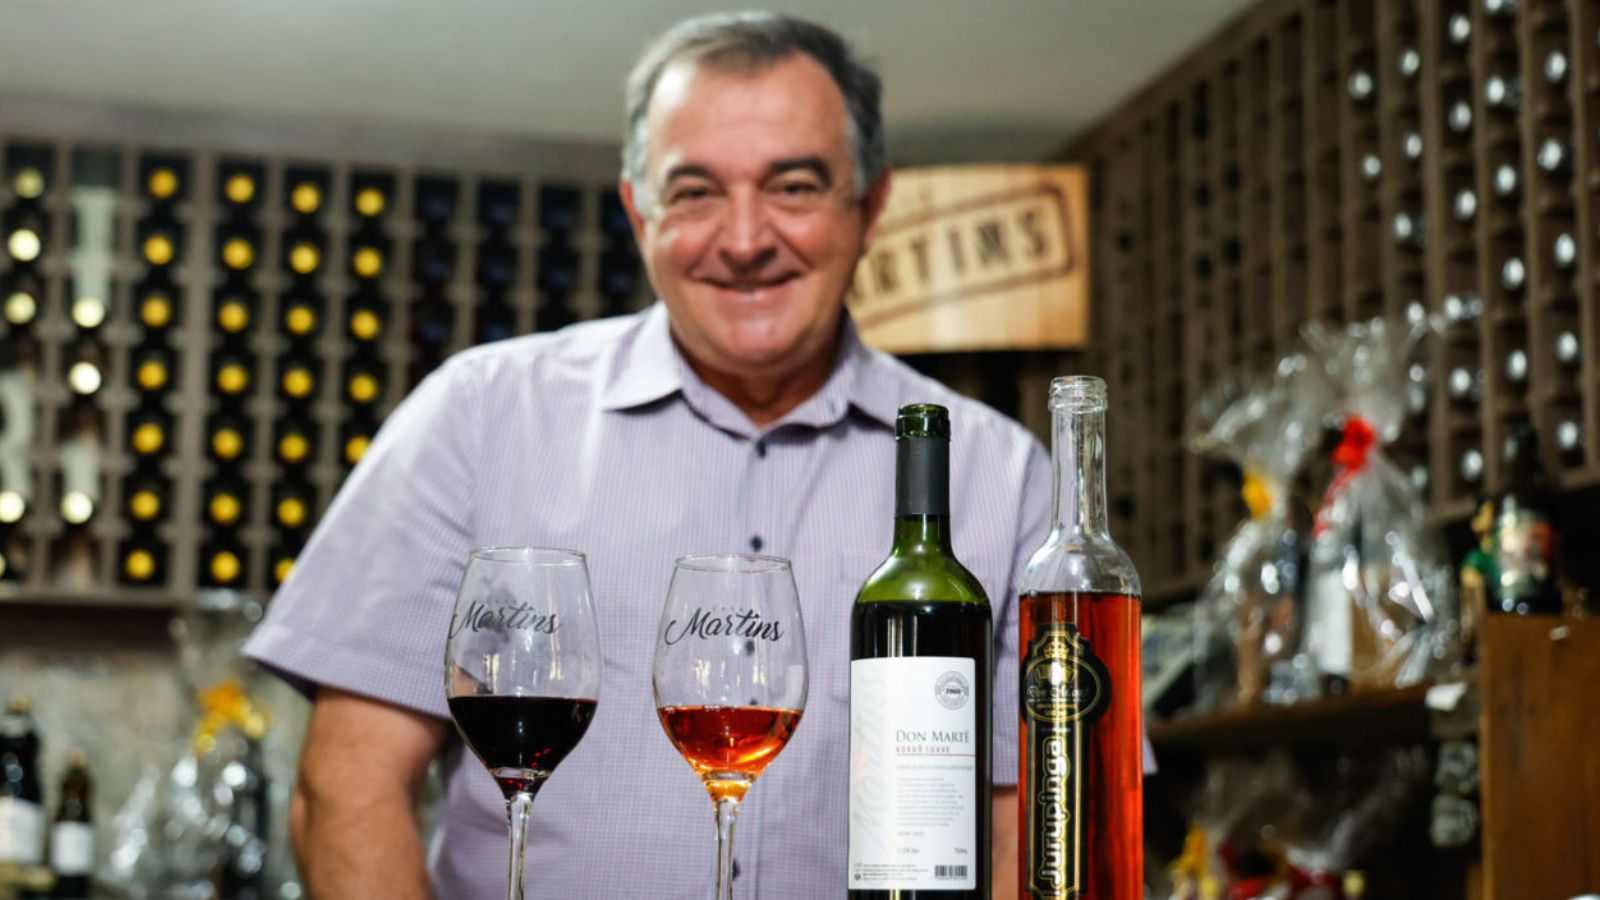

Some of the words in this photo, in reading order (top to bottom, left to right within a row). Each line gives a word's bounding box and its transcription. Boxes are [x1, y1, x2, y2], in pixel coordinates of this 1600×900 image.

[448, 599, 560, 640] Martins
[664, 607, 784, 646] Martins
[1039, 738, 1069, 887] Jurupinga
